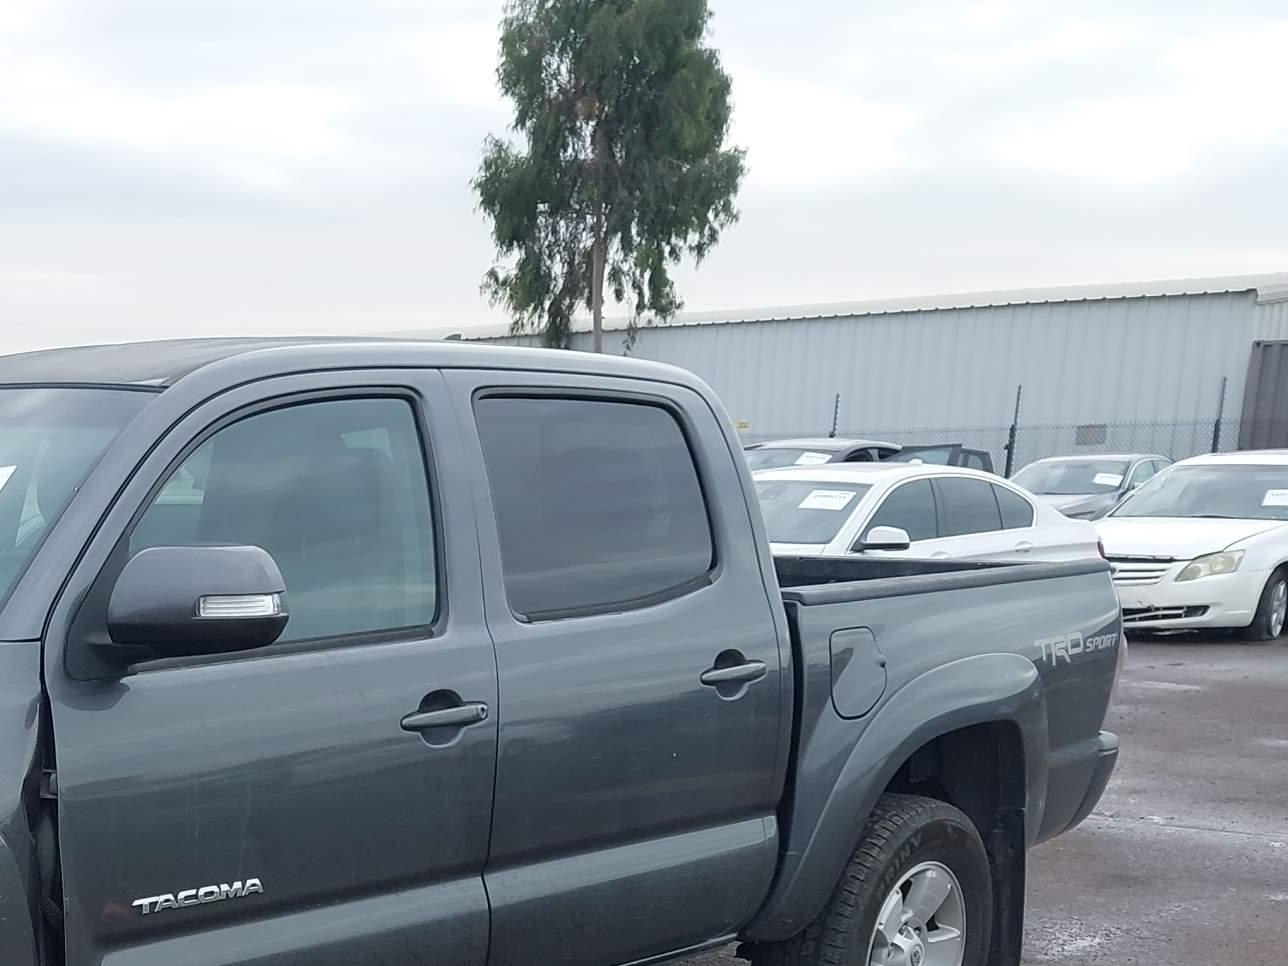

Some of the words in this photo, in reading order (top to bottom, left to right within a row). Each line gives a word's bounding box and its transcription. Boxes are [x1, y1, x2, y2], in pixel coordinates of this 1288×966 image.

[1034, 632, 1084, 666] TRD
[1086, 633, 1118, 652] SPORT
[132, 877, 264, 915] TACOMA
